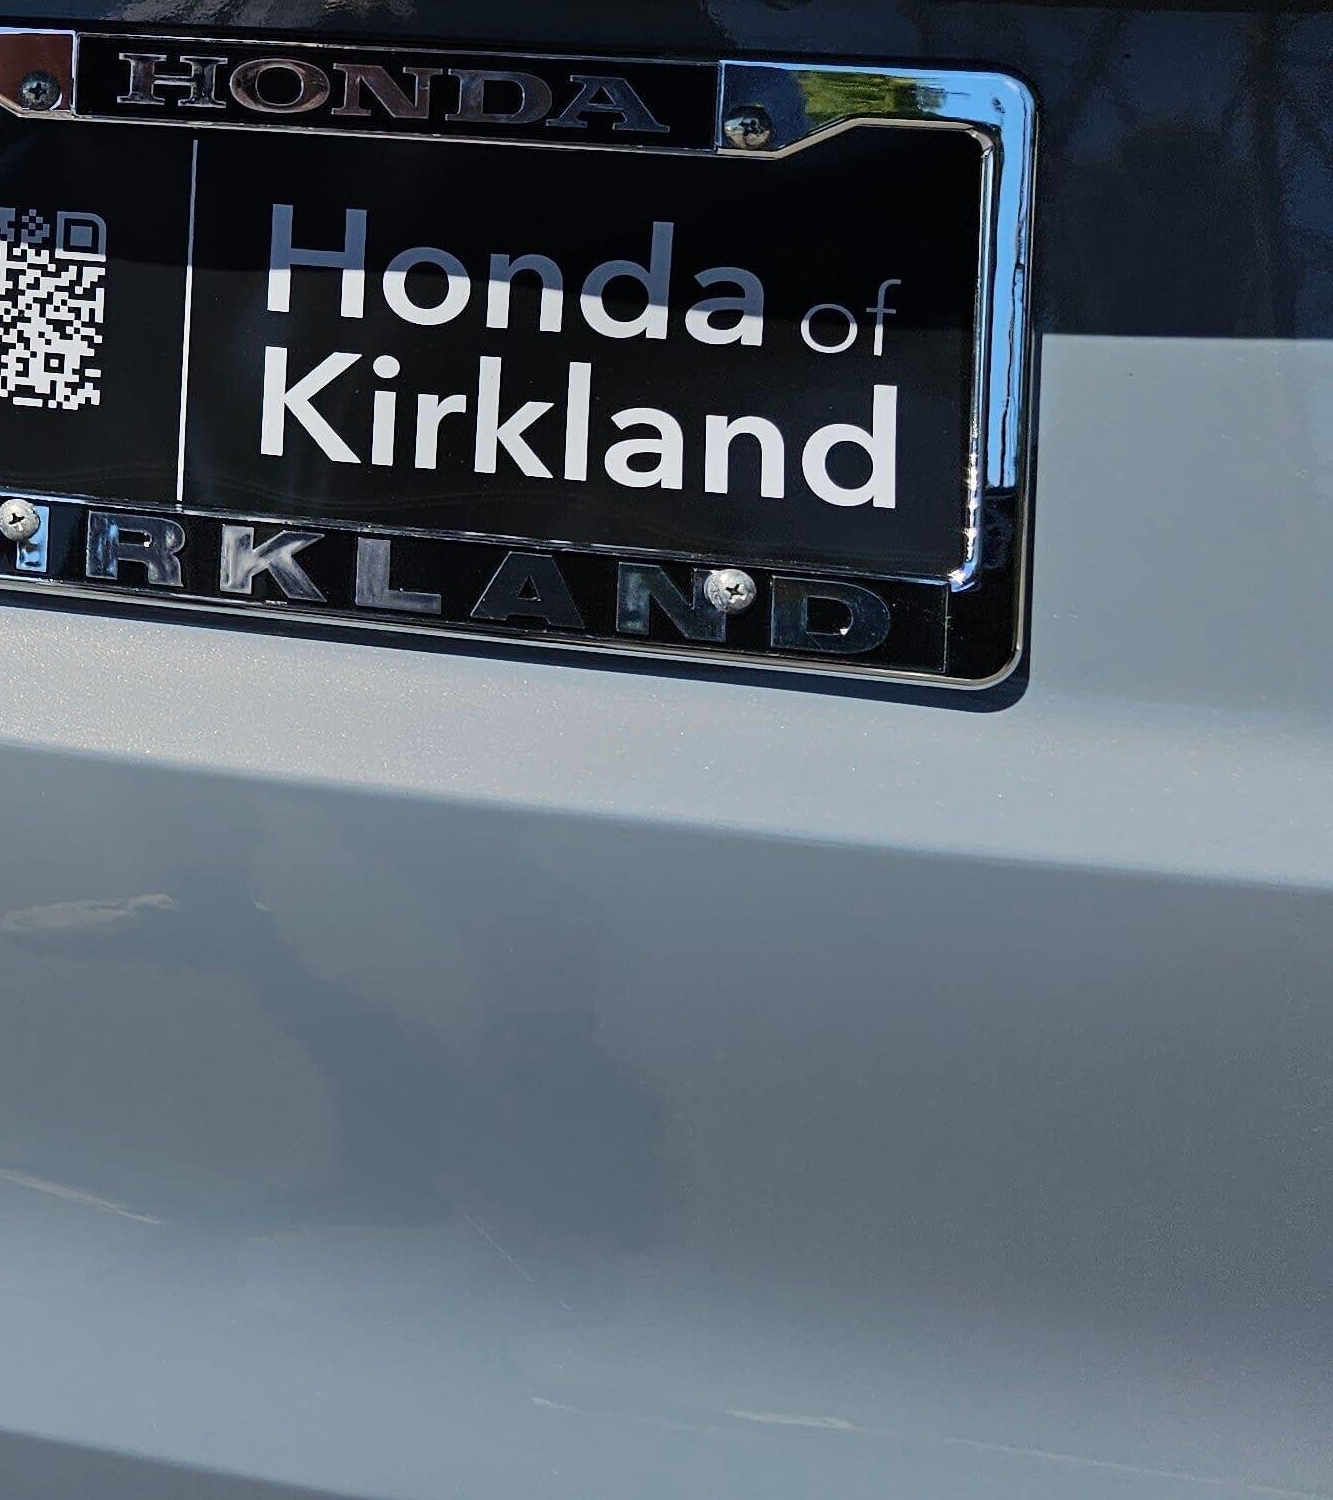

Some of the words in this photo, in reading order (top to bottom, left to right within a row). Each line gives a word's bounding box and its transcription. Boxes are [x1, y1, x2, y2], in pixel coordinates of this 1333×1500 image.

[116, 52, 671, 134] HONDA
[266, 203, 766, 347] Honda
[799, 277, 902, 357] of
[259, 345, 898, 510] Kirkland
